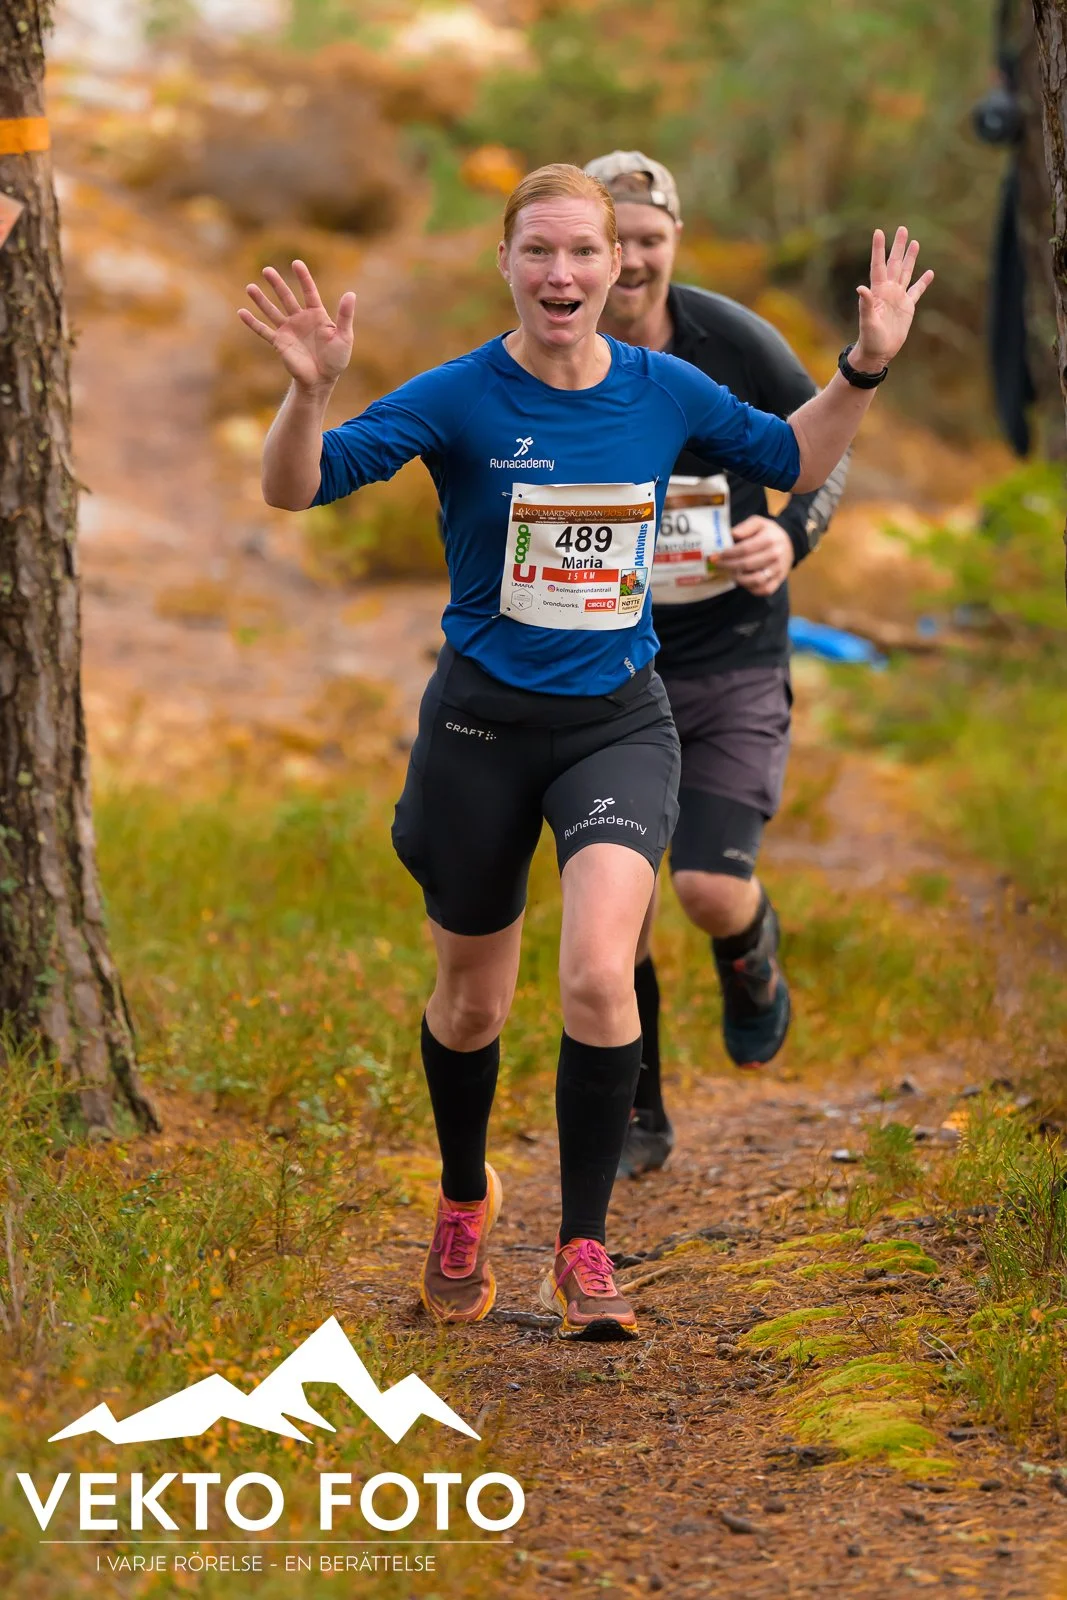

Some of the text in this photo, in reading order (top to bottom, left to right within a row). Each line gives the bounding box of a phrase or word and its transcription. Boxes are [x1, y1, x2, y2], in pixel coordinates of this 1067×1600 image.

[489, 458, 555, 471] Runacademy
[514, 524, 531, 564] coop
[555, 526, 613, 553] 489
[634, 523, 649, 567] Aktivitus
[561, 555, 603, 569] Maria
[583, 571, 596, 580] KM
[445, 721, 485, 738] CRAFT
[564, 814, 648, 841] Runacademy
